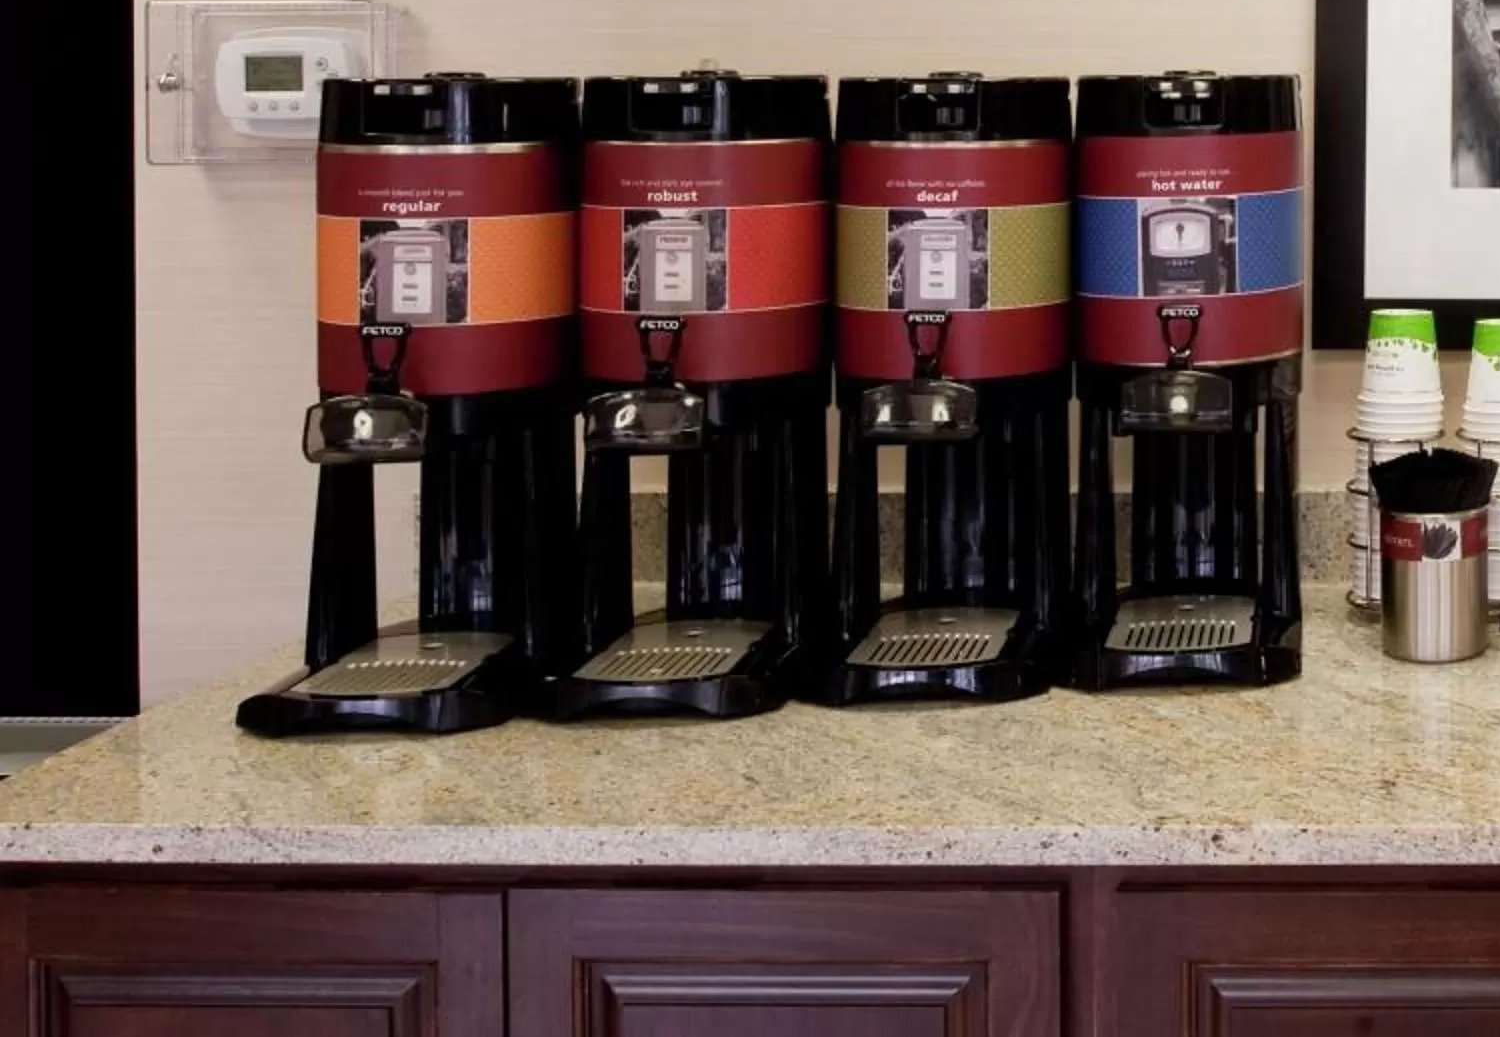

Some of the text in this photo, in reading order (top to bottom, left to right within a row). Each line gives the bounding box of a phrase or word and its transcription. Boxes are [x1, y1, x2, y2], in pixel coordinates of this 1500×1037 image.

[1151, 179, 1222, 191] hot water
[647, 189, 698, 202] robust
[917, 190, 959, 202] decaf
[383, 200, 441, 214] regular
[362, 326, 404, 335] FETCO
[640, 319, 679, 330] FETCO
